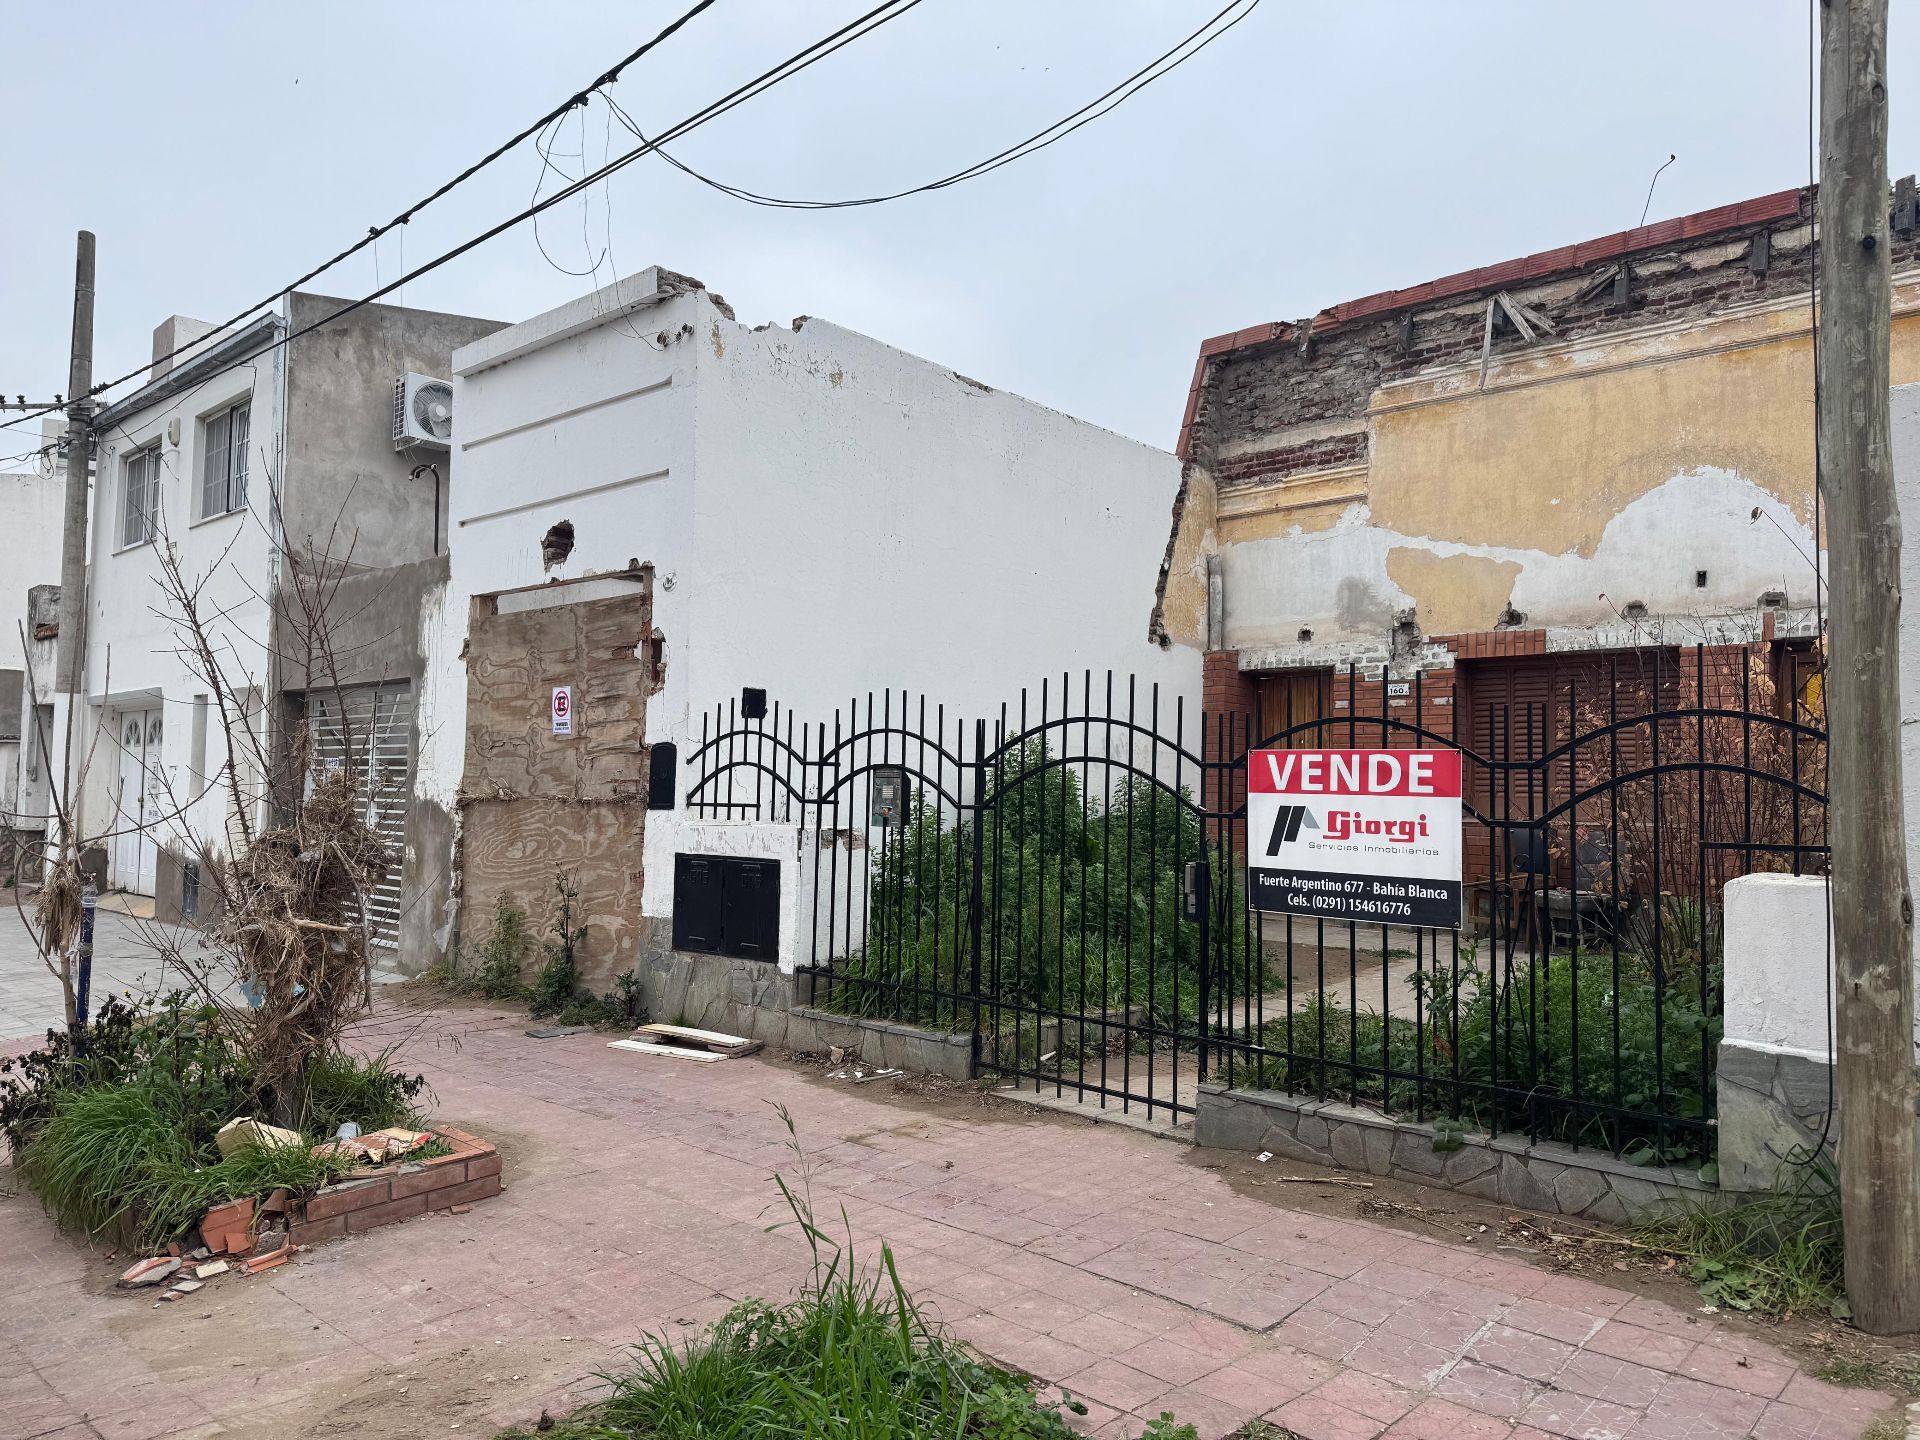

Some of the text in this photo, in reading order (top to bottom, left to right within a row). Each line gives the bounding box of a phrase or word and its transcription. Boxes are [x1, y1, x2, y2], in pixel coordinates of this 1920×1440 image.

[1266, 753, 1434, 794] VENDE
[1323, 811, 1429, 843] Giorgi
[1308, 842, 1439, 856] Servicios Inmobiliarios
[1259, 873, 1290, 887] Fuerte
[1291, 876, 1342, 892] Argentino
[1344, 881, 1364, 893] 677
[1373, 882, 1405, 897] Bahía
[1408, 884, 1448, 900] Blanca
[1287, 893, 1411, 915] Cels. (0291) 154616776
